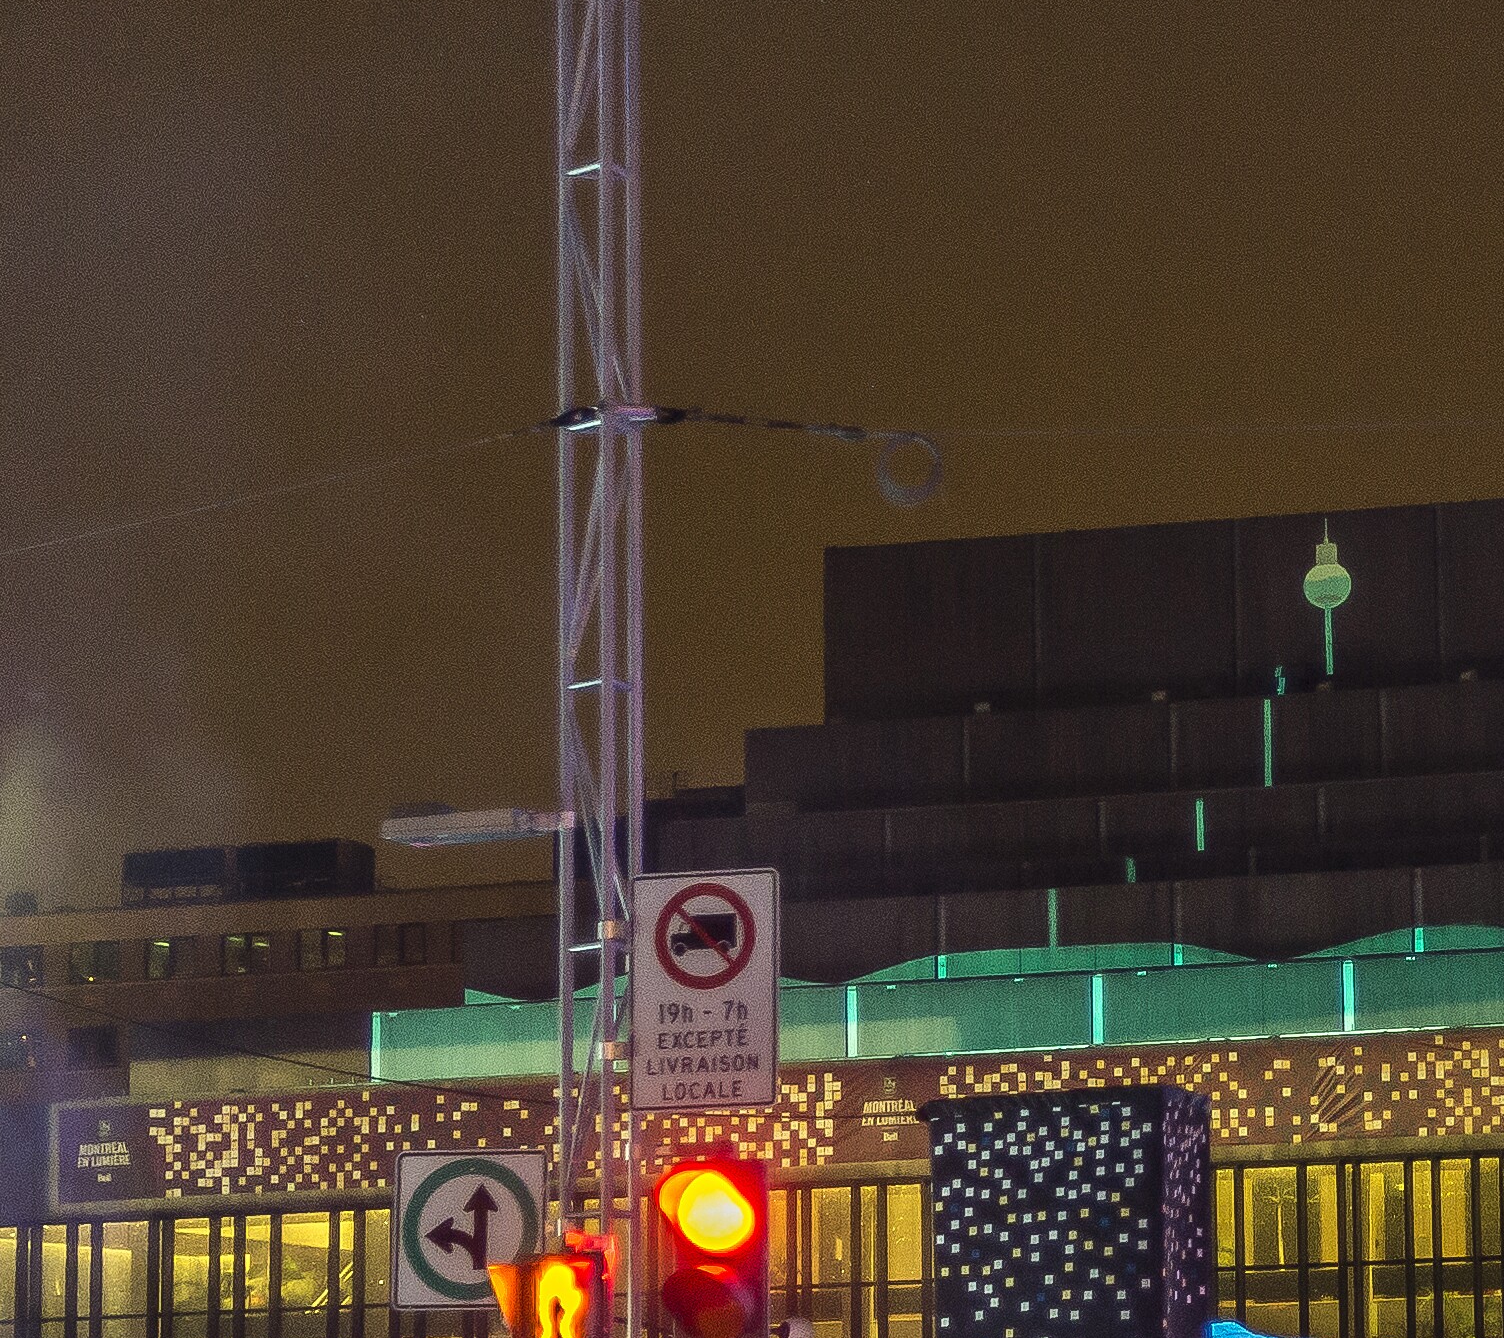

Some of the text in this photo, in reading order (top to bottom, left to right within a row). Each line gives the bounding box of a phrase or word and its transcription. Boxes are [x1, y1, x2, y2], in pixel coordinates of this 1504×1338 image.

[659, 1003, 694, 1024] 19h
[723, 999, 748, 1021] 7h
[658, 1023, 748, 1049] EXCEPTÉ
[647, 1054, 760, 1075] LIVRAISON
[662, 1080, 743, 1101] LOCALE
